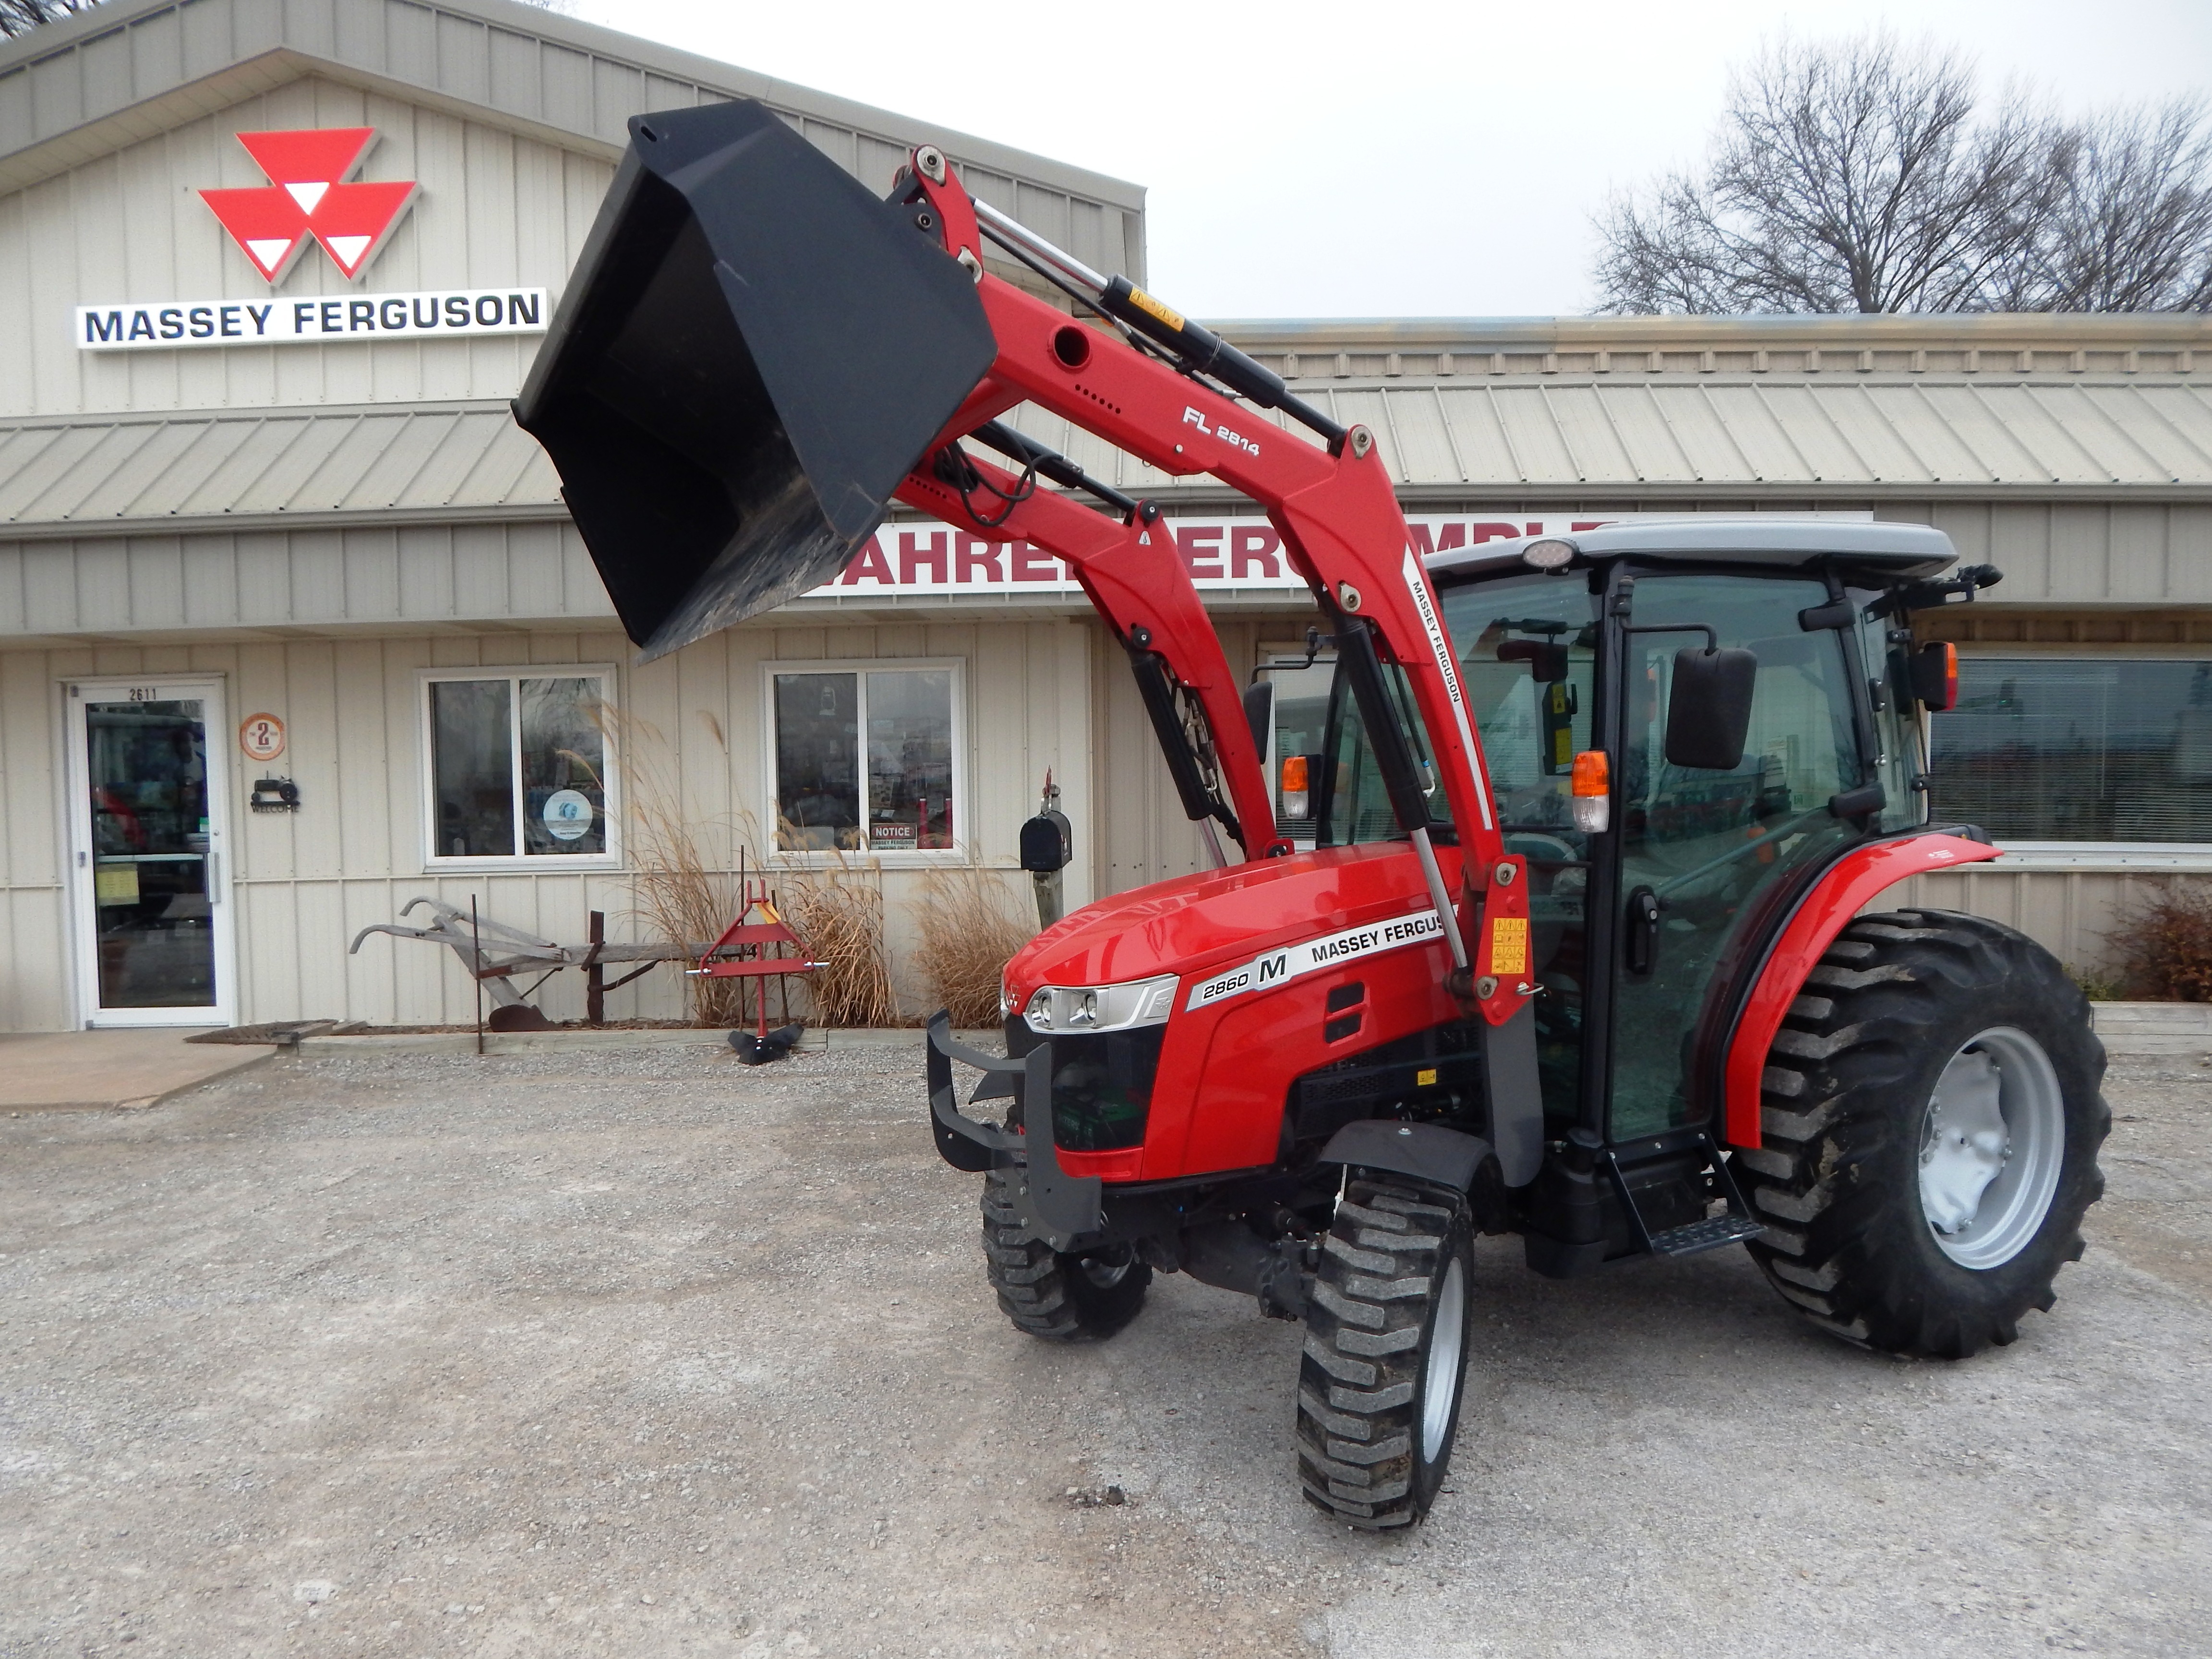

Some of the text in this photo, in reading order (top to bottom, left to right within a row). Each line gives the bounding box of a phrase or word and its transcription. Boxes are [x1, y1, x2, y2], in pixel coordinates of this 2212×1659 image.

[85, 293, 540, 342] MASSEY FERGUSON
[1183, 406, 1260, 456] FL 2814
[1413, 581, 1460, 703] MASSEY FERGUSON
[130, 688, 156, 700] 2611
[257, 722, 269, 745] 2
[250, 802, 300, 813] WELCOME
[876, 827, 910, 836] NOTICE
[1203, 915, 1443, 999] 2860 M MASSEY FERGU
